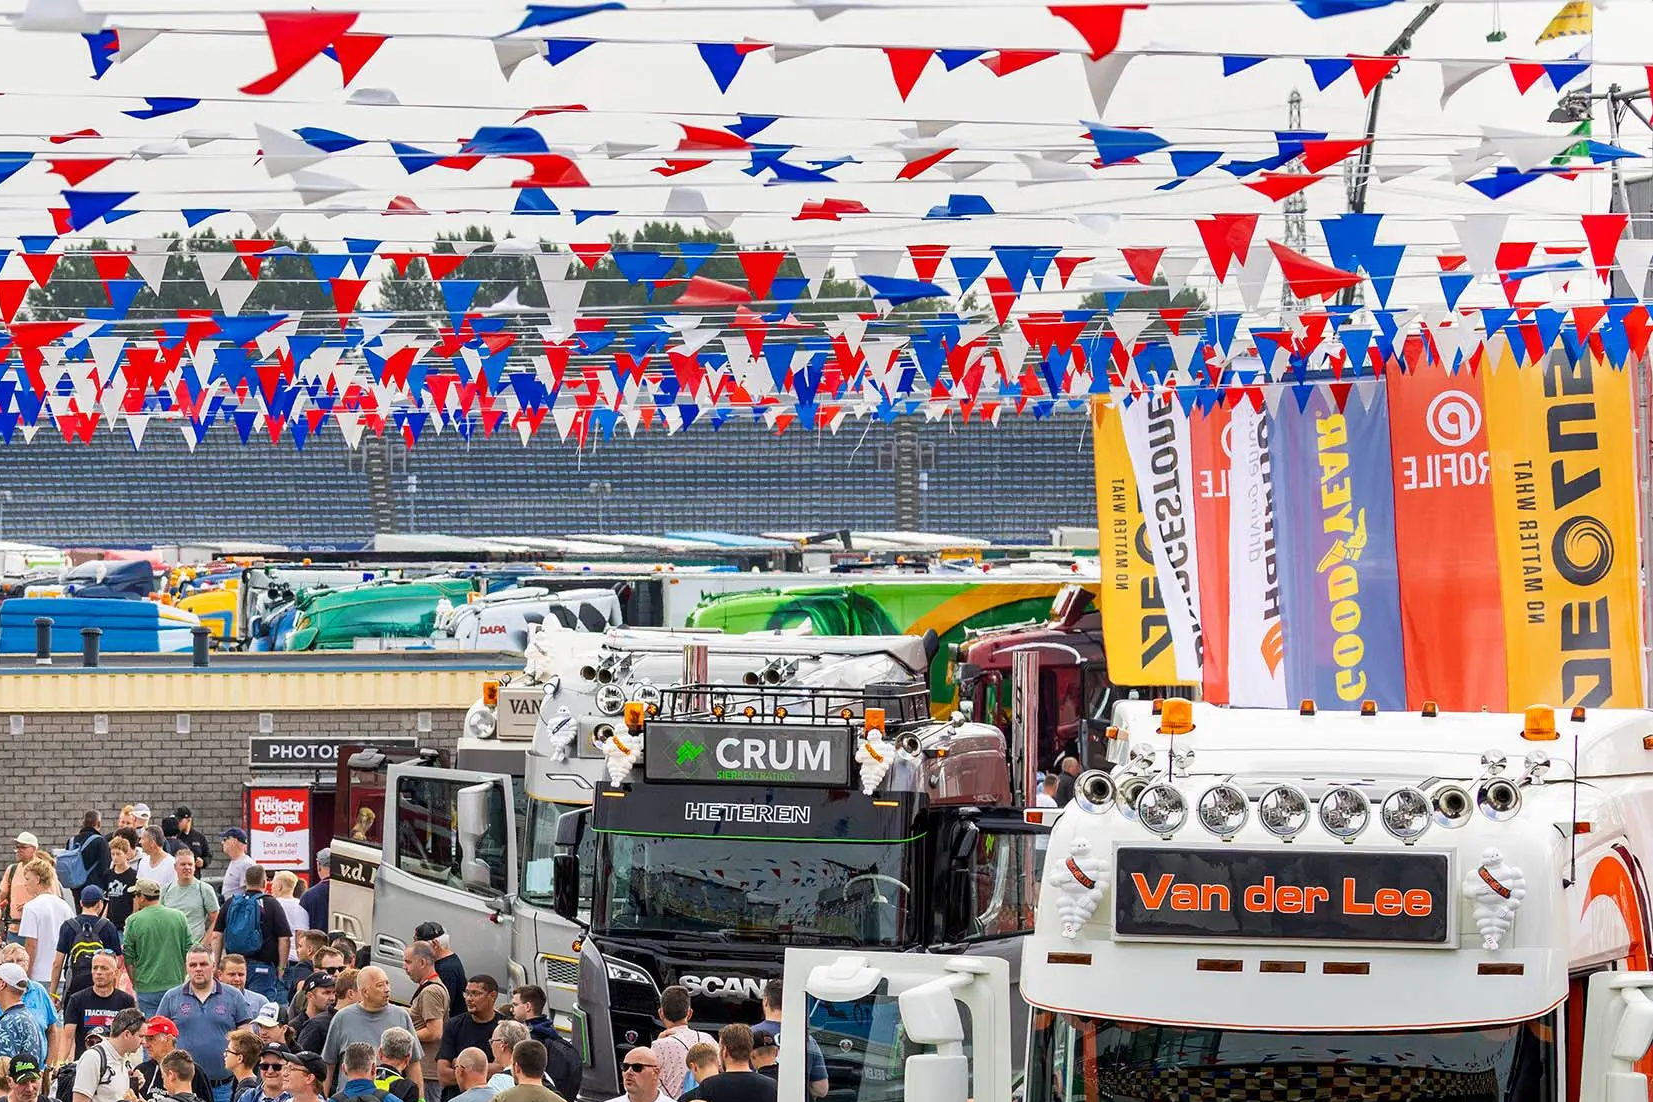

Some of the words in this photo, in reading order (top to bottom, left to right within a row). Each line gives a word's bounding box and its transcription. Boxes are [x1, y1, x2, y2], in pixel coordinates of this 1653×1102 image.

[480, 625, 507, 635] DAPA
[715, 737, 831, 771] CRUM
[684, 803, 811, 823] HETEREN
[1131, 872, 1231, 913] Van
[1243, 875, 1329, 914] der
[1342, 877, 1433, 917] Lee
